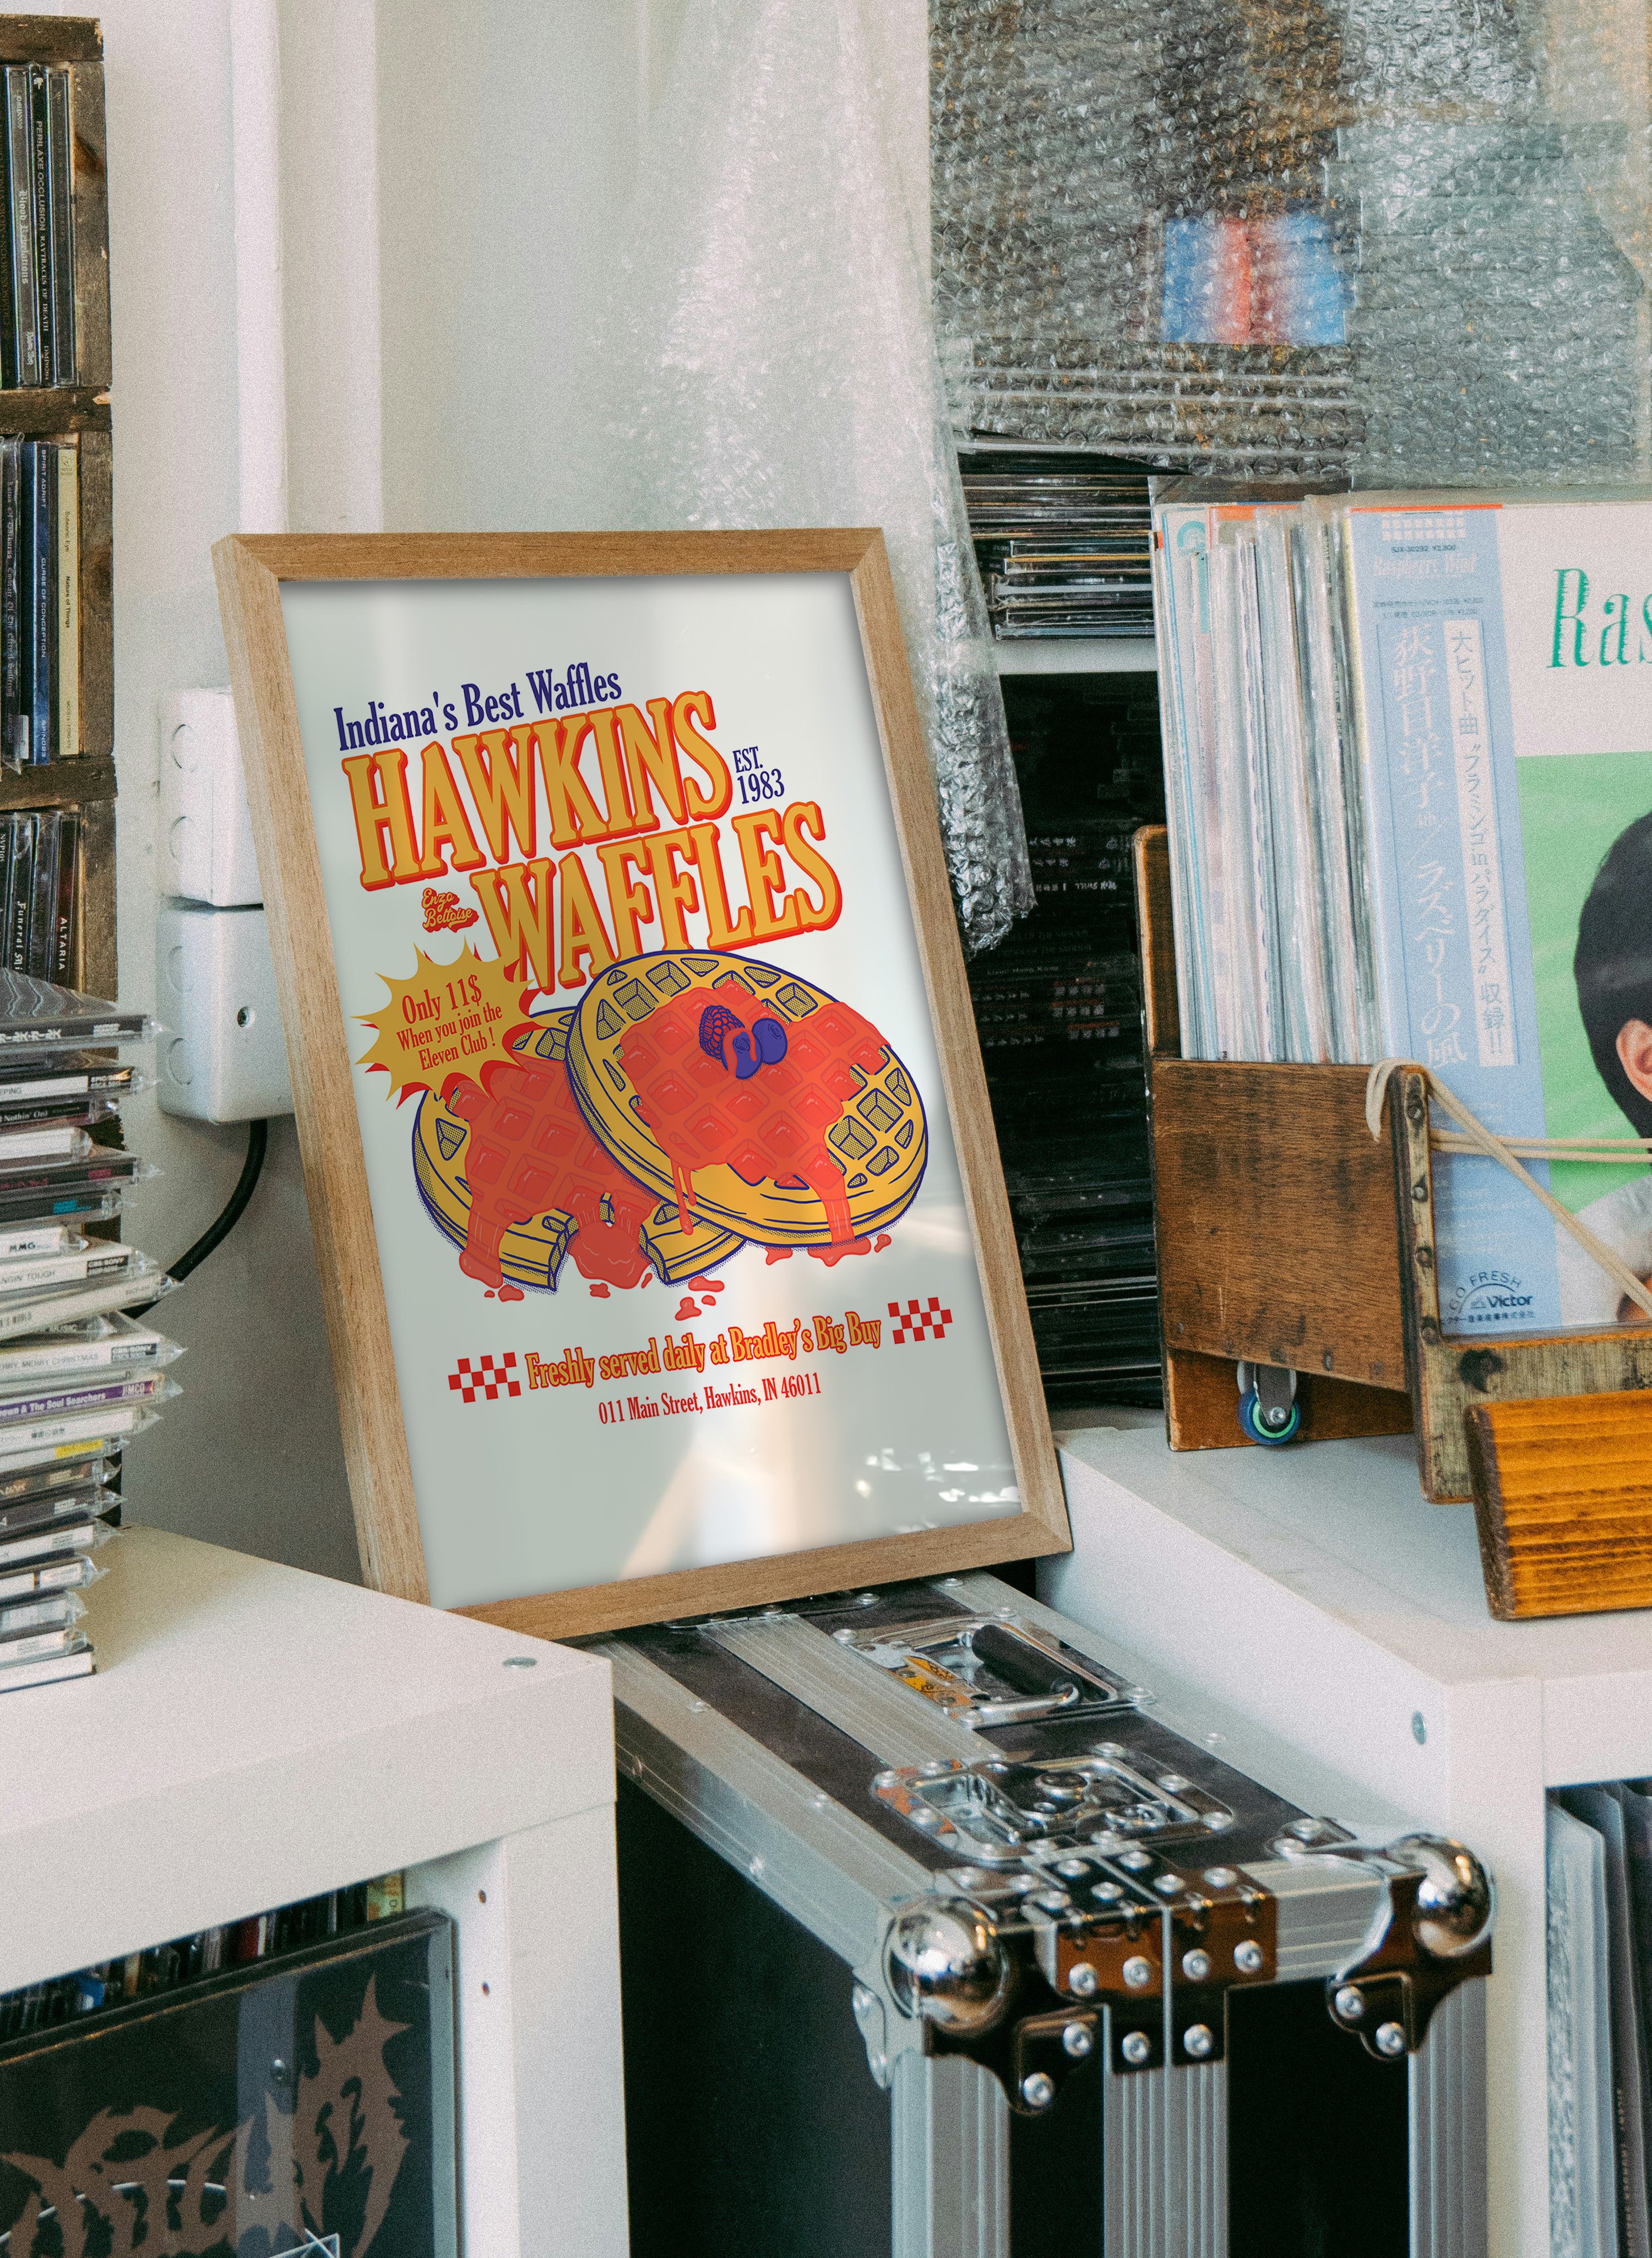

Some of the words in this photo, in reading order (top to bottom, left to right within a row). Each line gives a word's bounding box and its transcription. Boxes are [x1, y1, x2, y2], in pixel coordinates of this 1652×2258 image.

[36, 120, 45, 170] PERILAXE
[37, 171, 46, 231] OCCLUSION
[40, 235, 48, 285] RAYTRACES
[40, 588, 46, 601] OF
[334, 691, 459, 751] Indiana's
[461, 683, 524, 727] Best
[526, 662, 622, 714] Waffles
[732, 746, 763, 773] EST.
[341, 691, 733, 892] HAWKINS
[737, 768, 785, 805] 1983
[422, 888, 460, 913] Enzo
[422, 907, 479, 933] Beltoise
[469, 800, 843, 996] WAFFLES
[15, 900, 26, 948] Funeral
[58, 916, 68, 971] ALTARIA
[401, 989, 442, 1025] Only
[445, 974, 482, 1011] 11$
[396, 1027, 433, 1052] When
[434, 1022, 457, 1043] you
[458, 1008, 482, 1032] join
[482, 1001, 503, 1023] the
[417, 1044, 459, 1071] Eleven
[460, 1029, 488, 1060] Club
[9, 1241, 36, 1253] MMG
[1449, 1286, 1466, 1312] GO
[1469, 1269, 1523, 1290] FRESH
[1486, 1293, 1533, 1309] Victor
[525, 1346, 596, 1392] Freshly
[598, 1337, 661, 1382] served
[663, 1331, 707, 1376] daily
[709, 1338, 730, 1366] at
[729, 1318, 813, 1362] Bradley's
[813, 1313, 848, 1354] Big
[845, 1311, 882, 1348] Buy
[30, 1402, 44, 1412] The
[47, 1399, 64, 1410] Soul
[66, 1393, 106, 1405] Searchers
[597, 1399, 626, 1425] 011
[627, 1392, 660, 1422] Main
[661, 1385, 704, 1419] Street,
[703, 1377, 762, 1411] Hawkins,
[762, 1376, 779, 1402] IN
[780, 1371, 823, 1399] 46011
